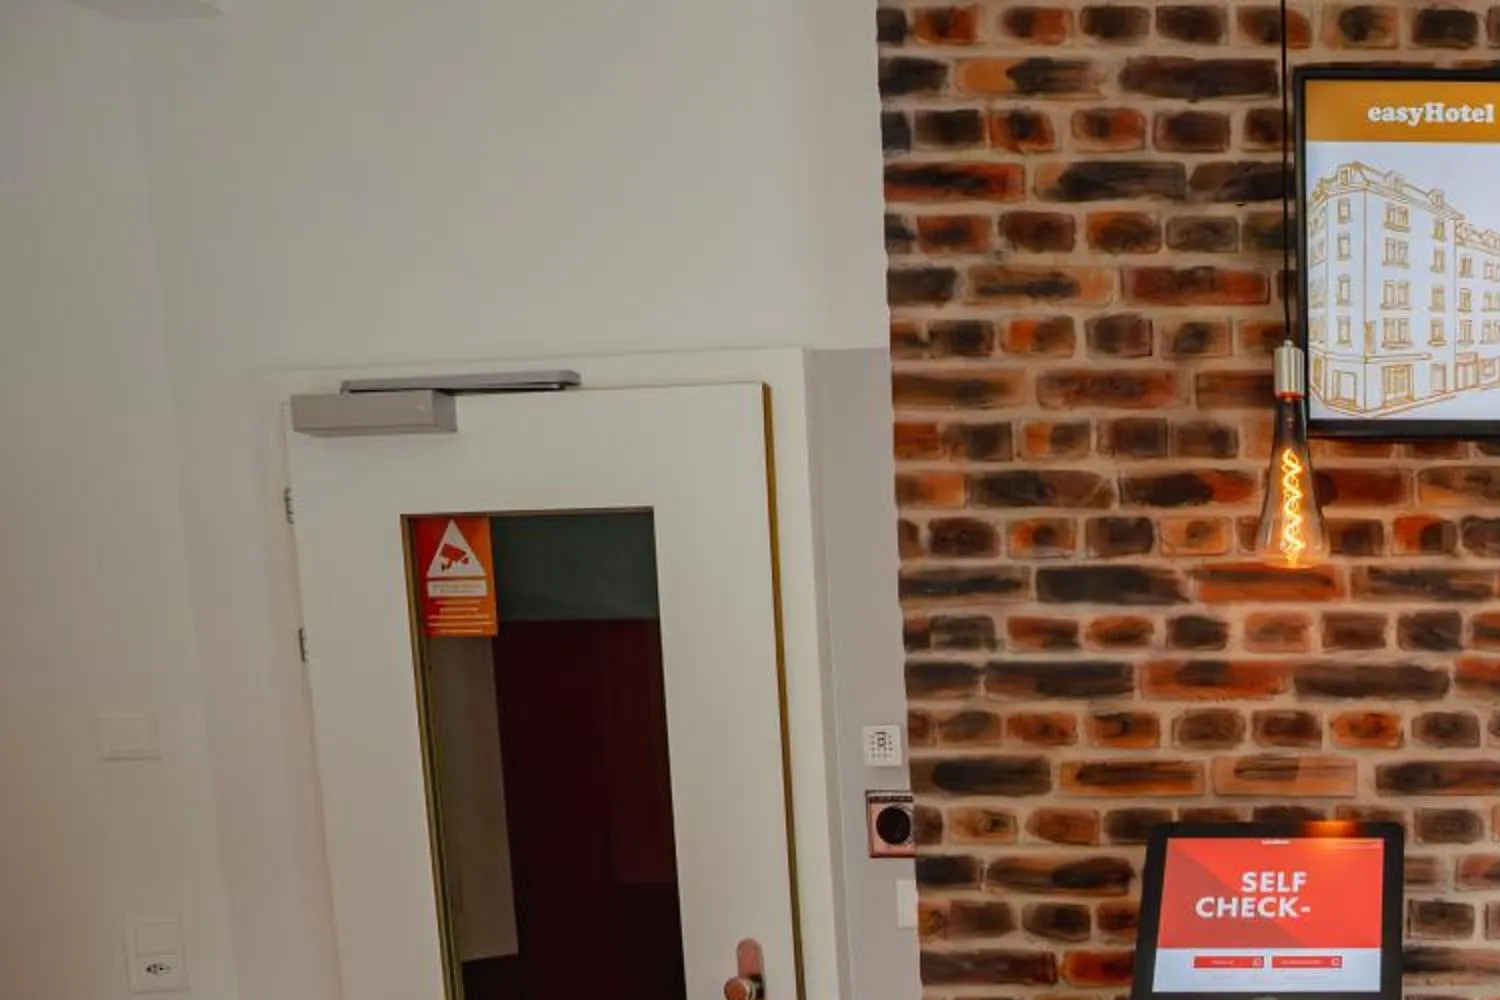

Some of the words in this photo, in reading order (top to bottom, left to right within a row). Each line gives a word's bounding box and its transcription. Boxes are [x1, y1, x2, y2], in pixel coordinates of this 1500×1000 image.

[1367, 102, 1495, 127] easyHotel
[1241, 871, 1307, 893] SELF
[1195, 896, 1311, 918] CHECK-
